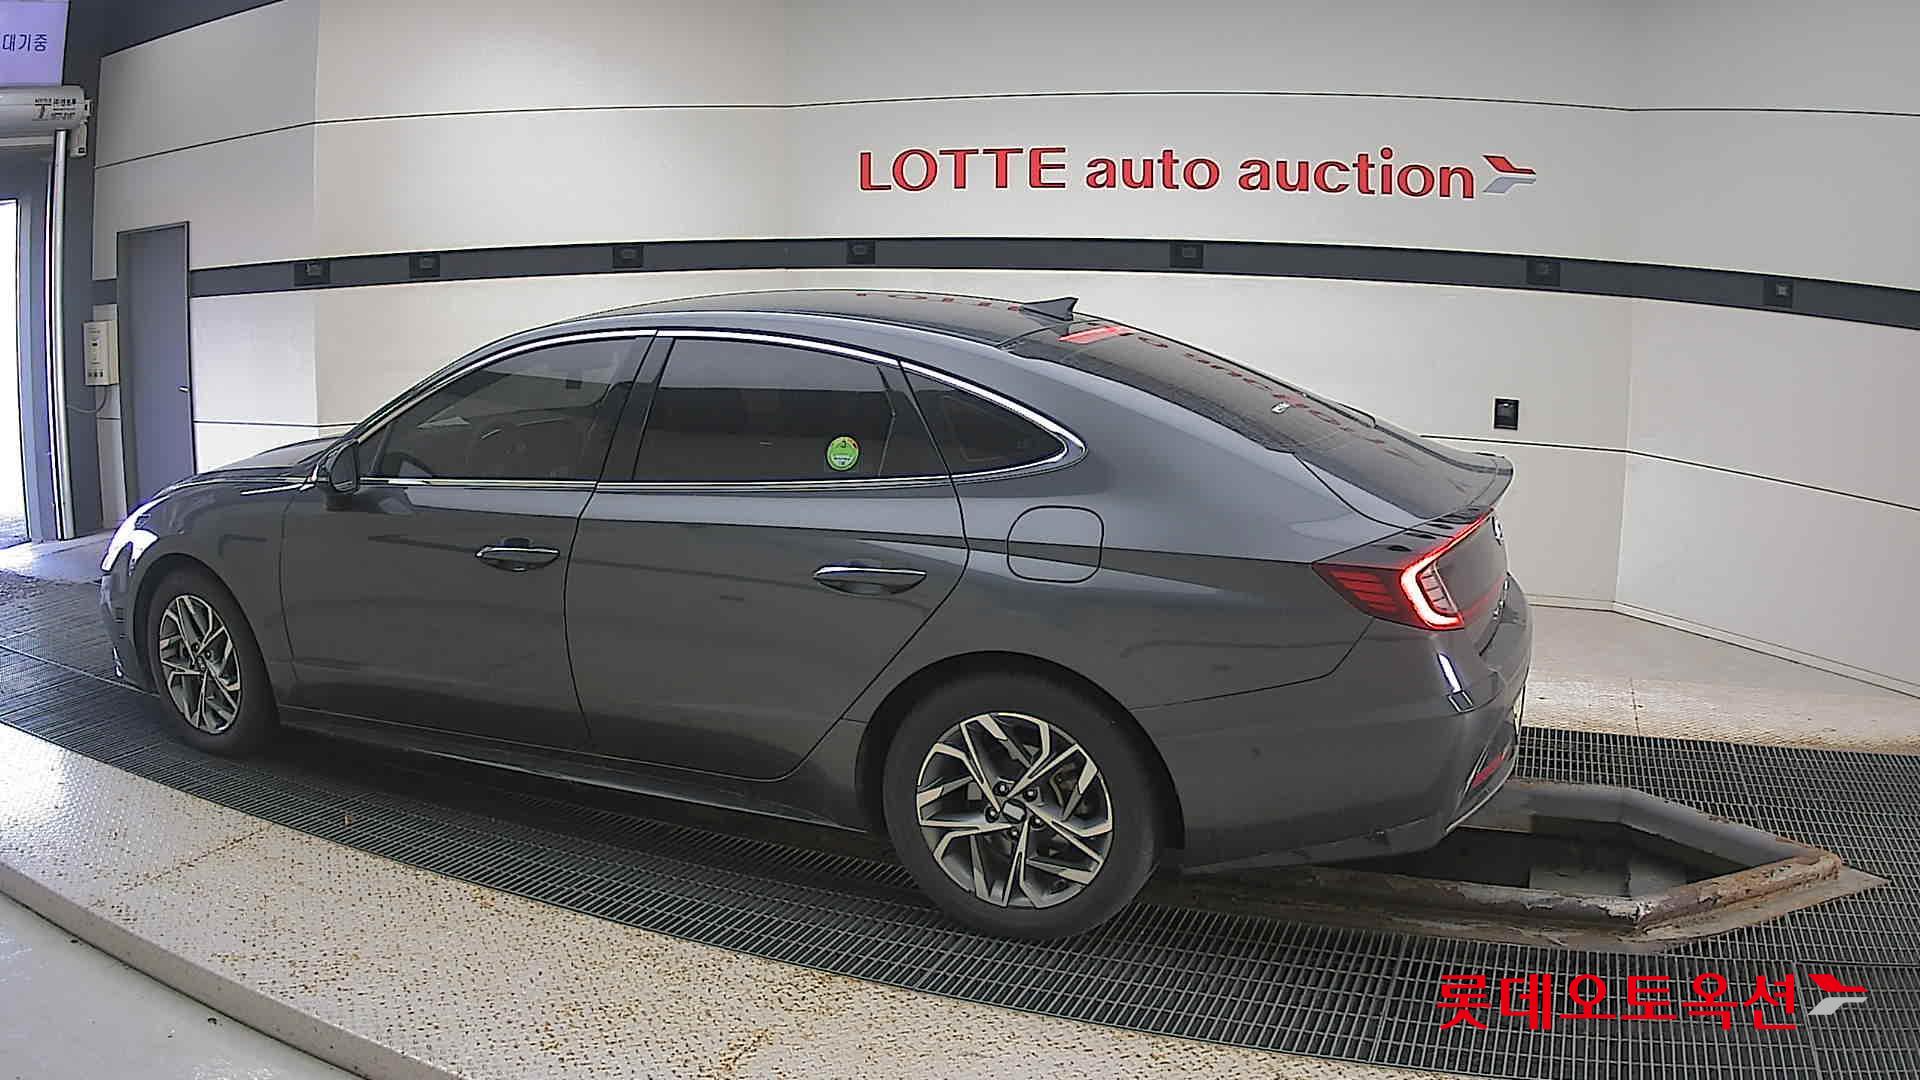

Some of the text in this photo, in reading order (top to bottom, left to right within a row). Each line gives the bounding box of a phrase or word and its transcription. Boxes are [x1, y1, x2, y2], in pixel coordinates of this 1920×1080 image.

[2, 33, 48, 52] 대기중
[858, 145, 1476, 199] LOTTE auto auction
